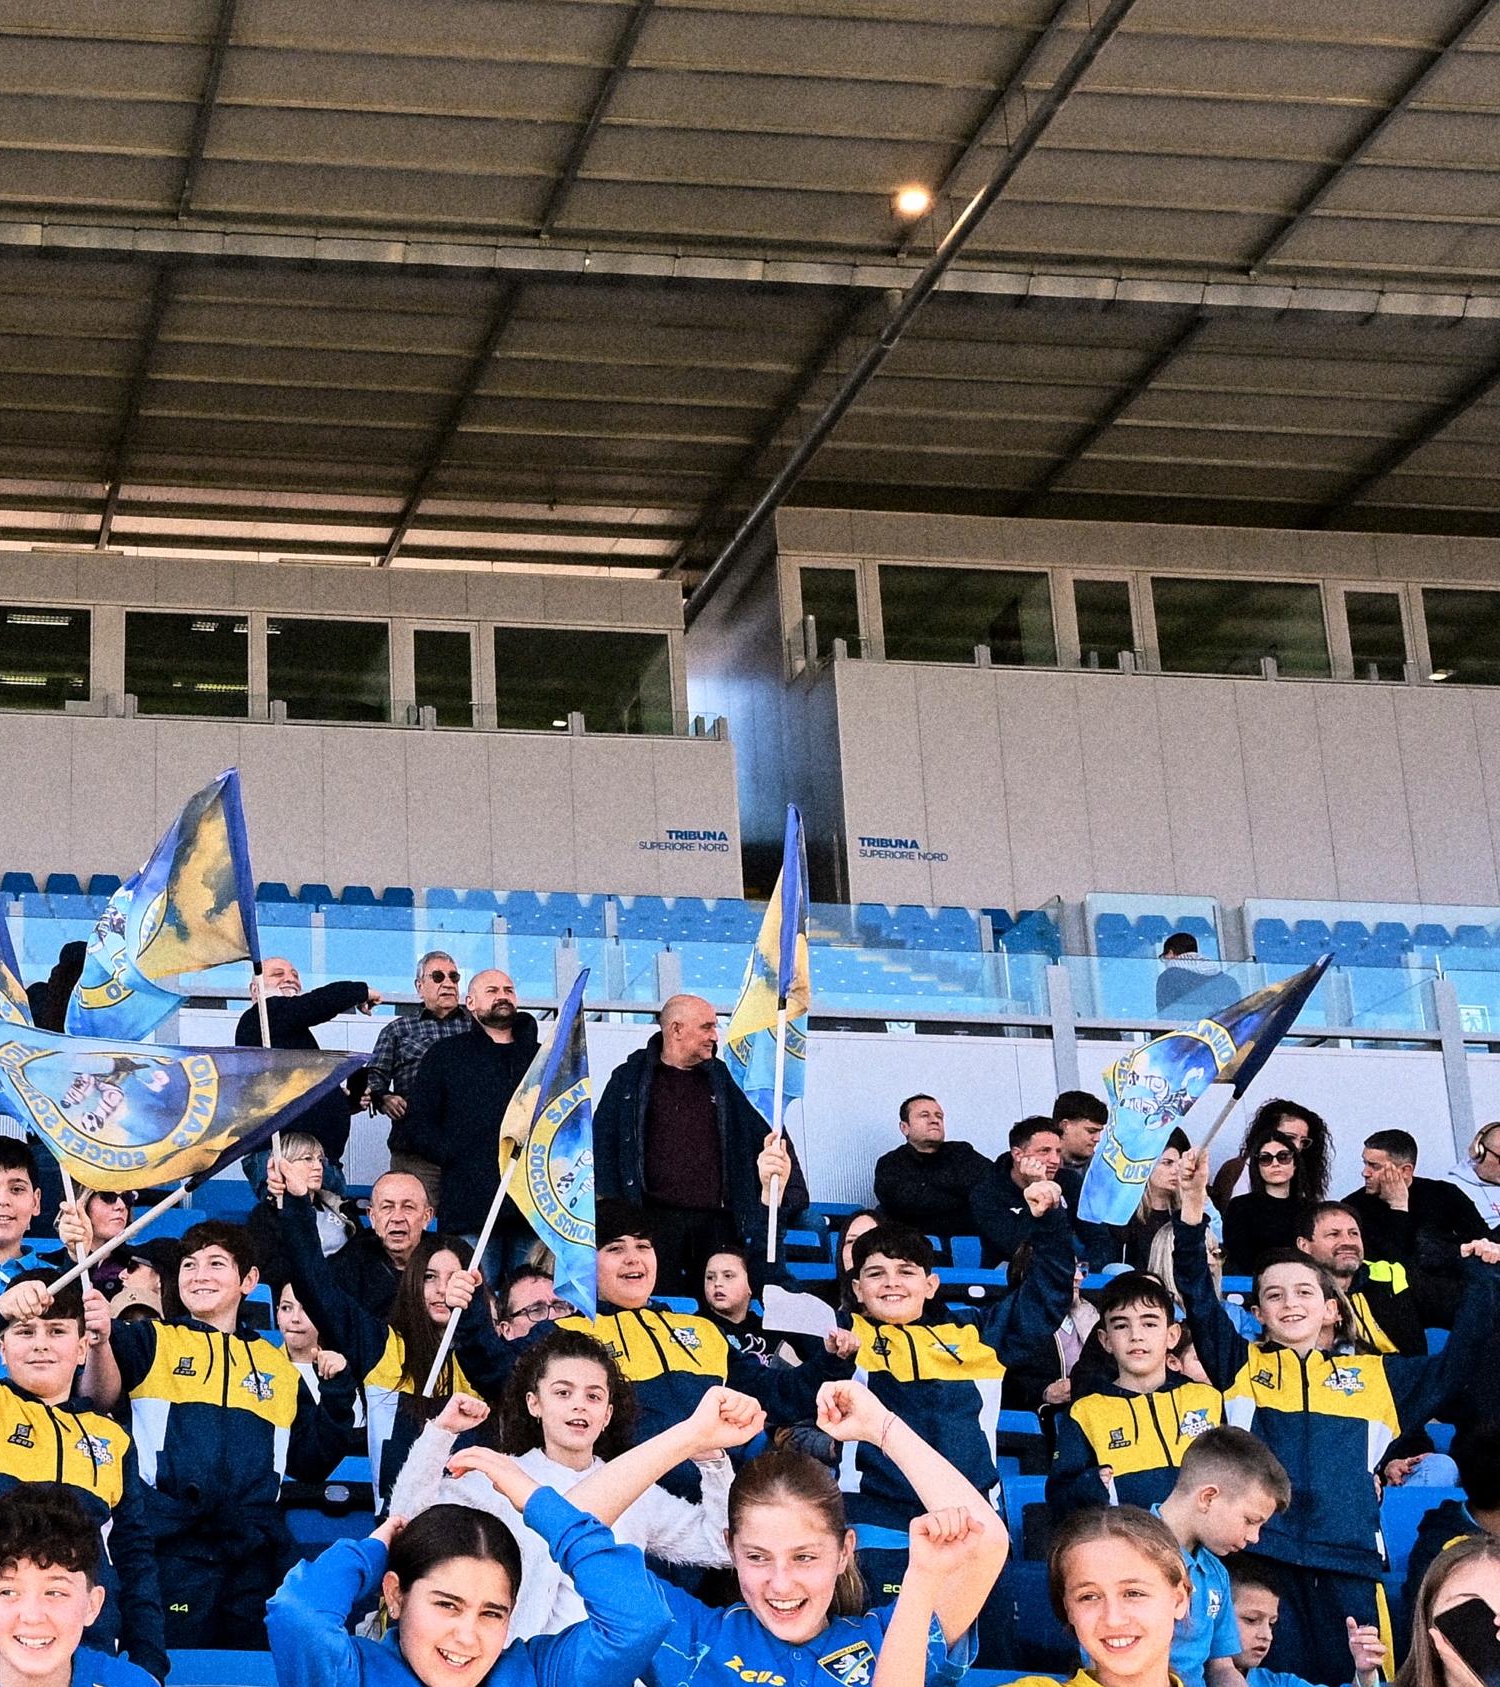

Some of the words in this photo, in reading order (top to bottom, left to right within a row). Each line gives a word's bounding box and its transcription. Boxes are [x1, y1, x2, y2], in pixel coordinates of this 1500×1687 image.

[666, 830, 728, 842] TRIBUNA
[638, 841, 696, 851] SUPERIORE
[698, 843, 729, 852] NORD
[857, 837, 920, 850] TRIBUNA
[858, 849, 916, 860] SUPERIORE
[917, 851, 949, 862] NORD
[546, 1083, 587, 1124] SAN
[530, 1143, 558, 1217] SOCCER
[554, 1212, 596, 1243] SCHOO
[169, 1603, 189, 1613] 44
[724, 1655, 787, 1687] Zeus
